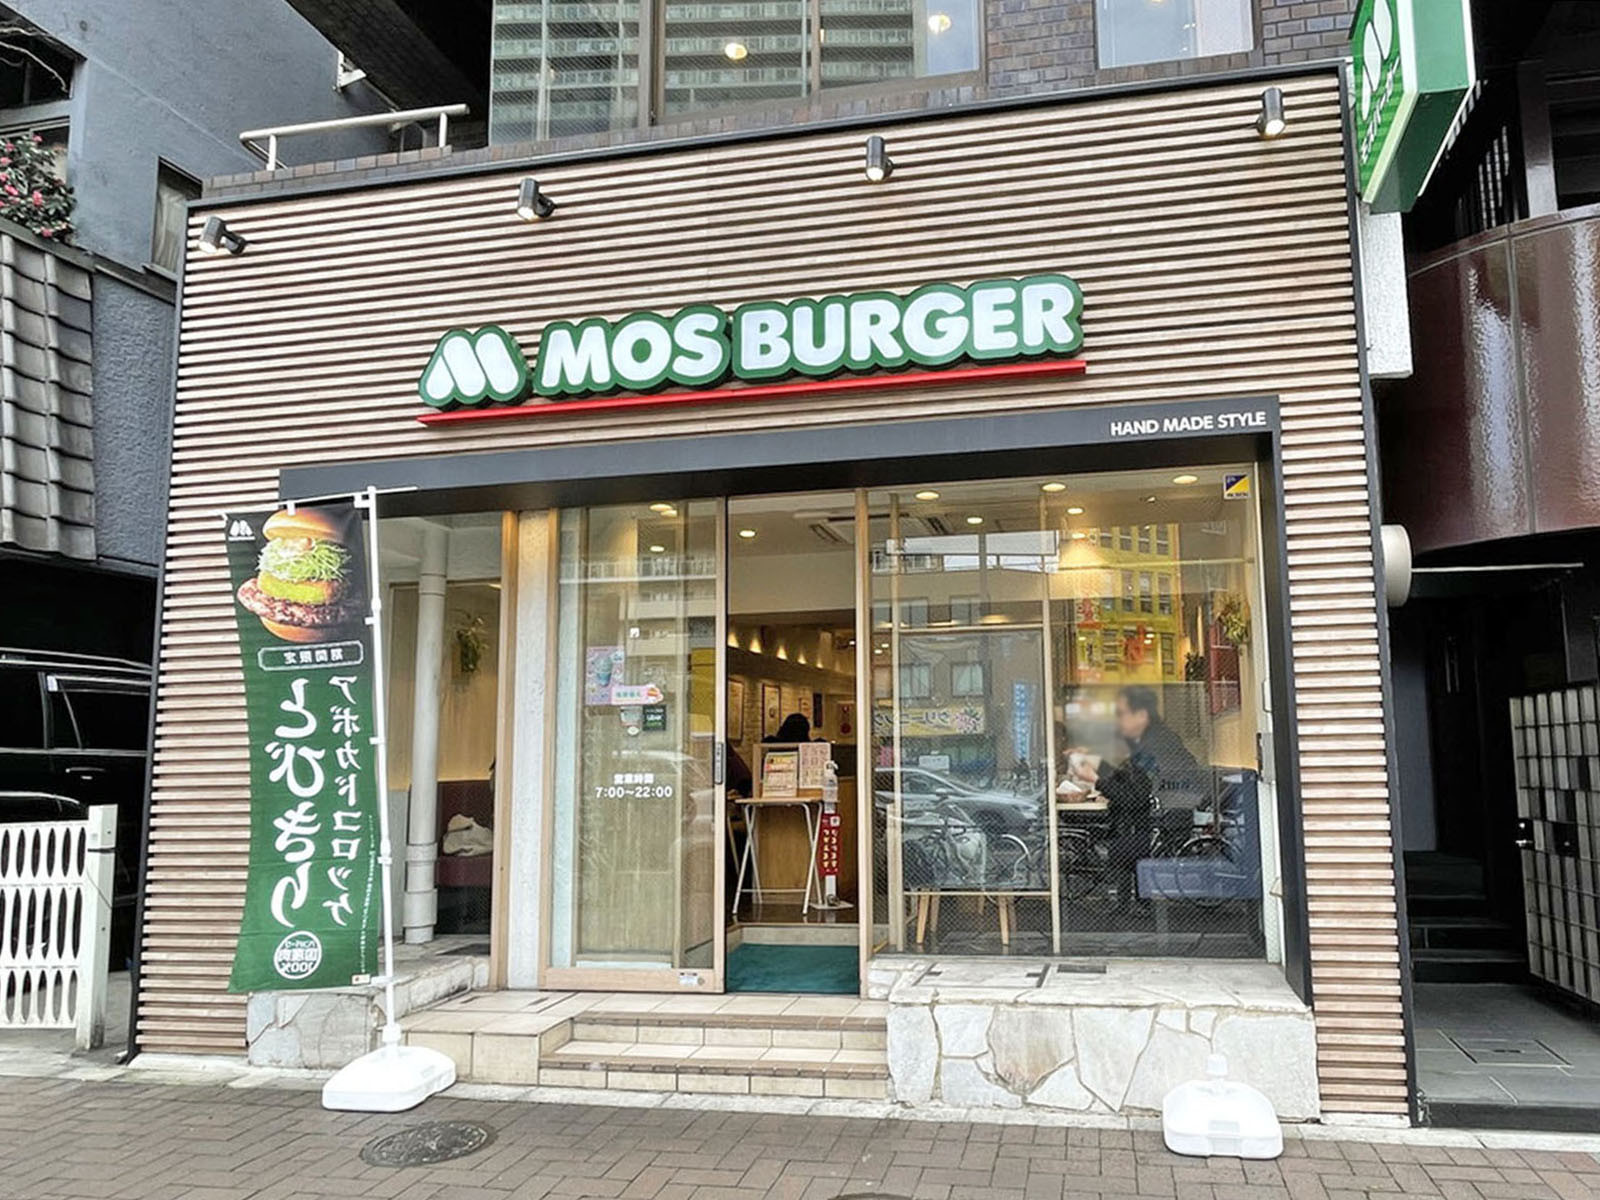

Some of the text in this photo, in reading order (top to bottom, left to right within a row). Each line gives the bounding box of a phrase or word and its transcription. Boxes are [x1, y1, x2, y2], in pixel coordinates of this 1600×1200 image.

[541, 312, 722, 388] MOS
[741, 282, 1077, 370] BURGER
[1110, 411, 1267, 436] HAND MADE STYLE
